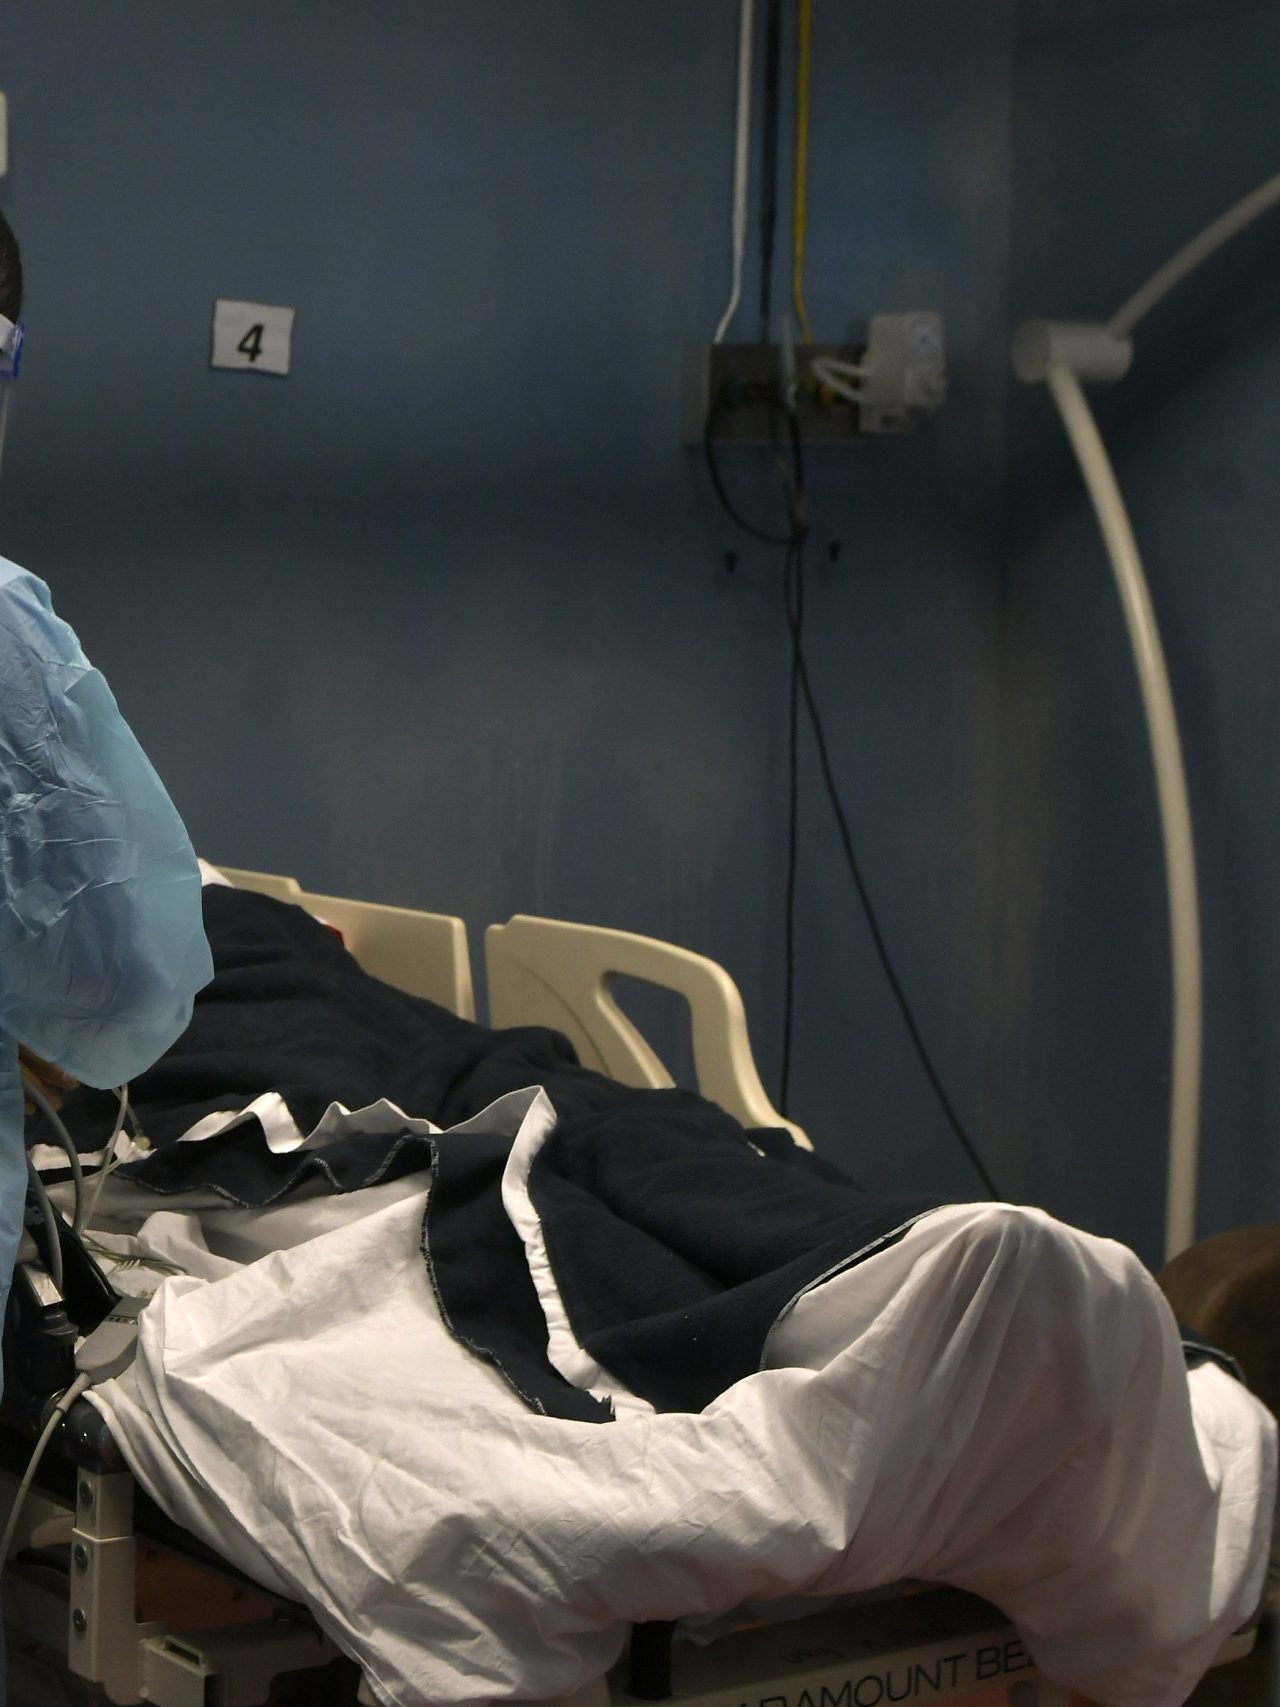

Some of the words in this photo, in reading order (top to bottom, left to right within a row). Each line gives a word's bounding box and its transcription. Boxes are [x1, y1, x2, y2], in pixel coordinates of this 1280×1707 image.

[236, 323, 265, 362] 4
[740, 1654, 967, 1707] AMOUNT
[976, 1640, 1035, 1681] BE
